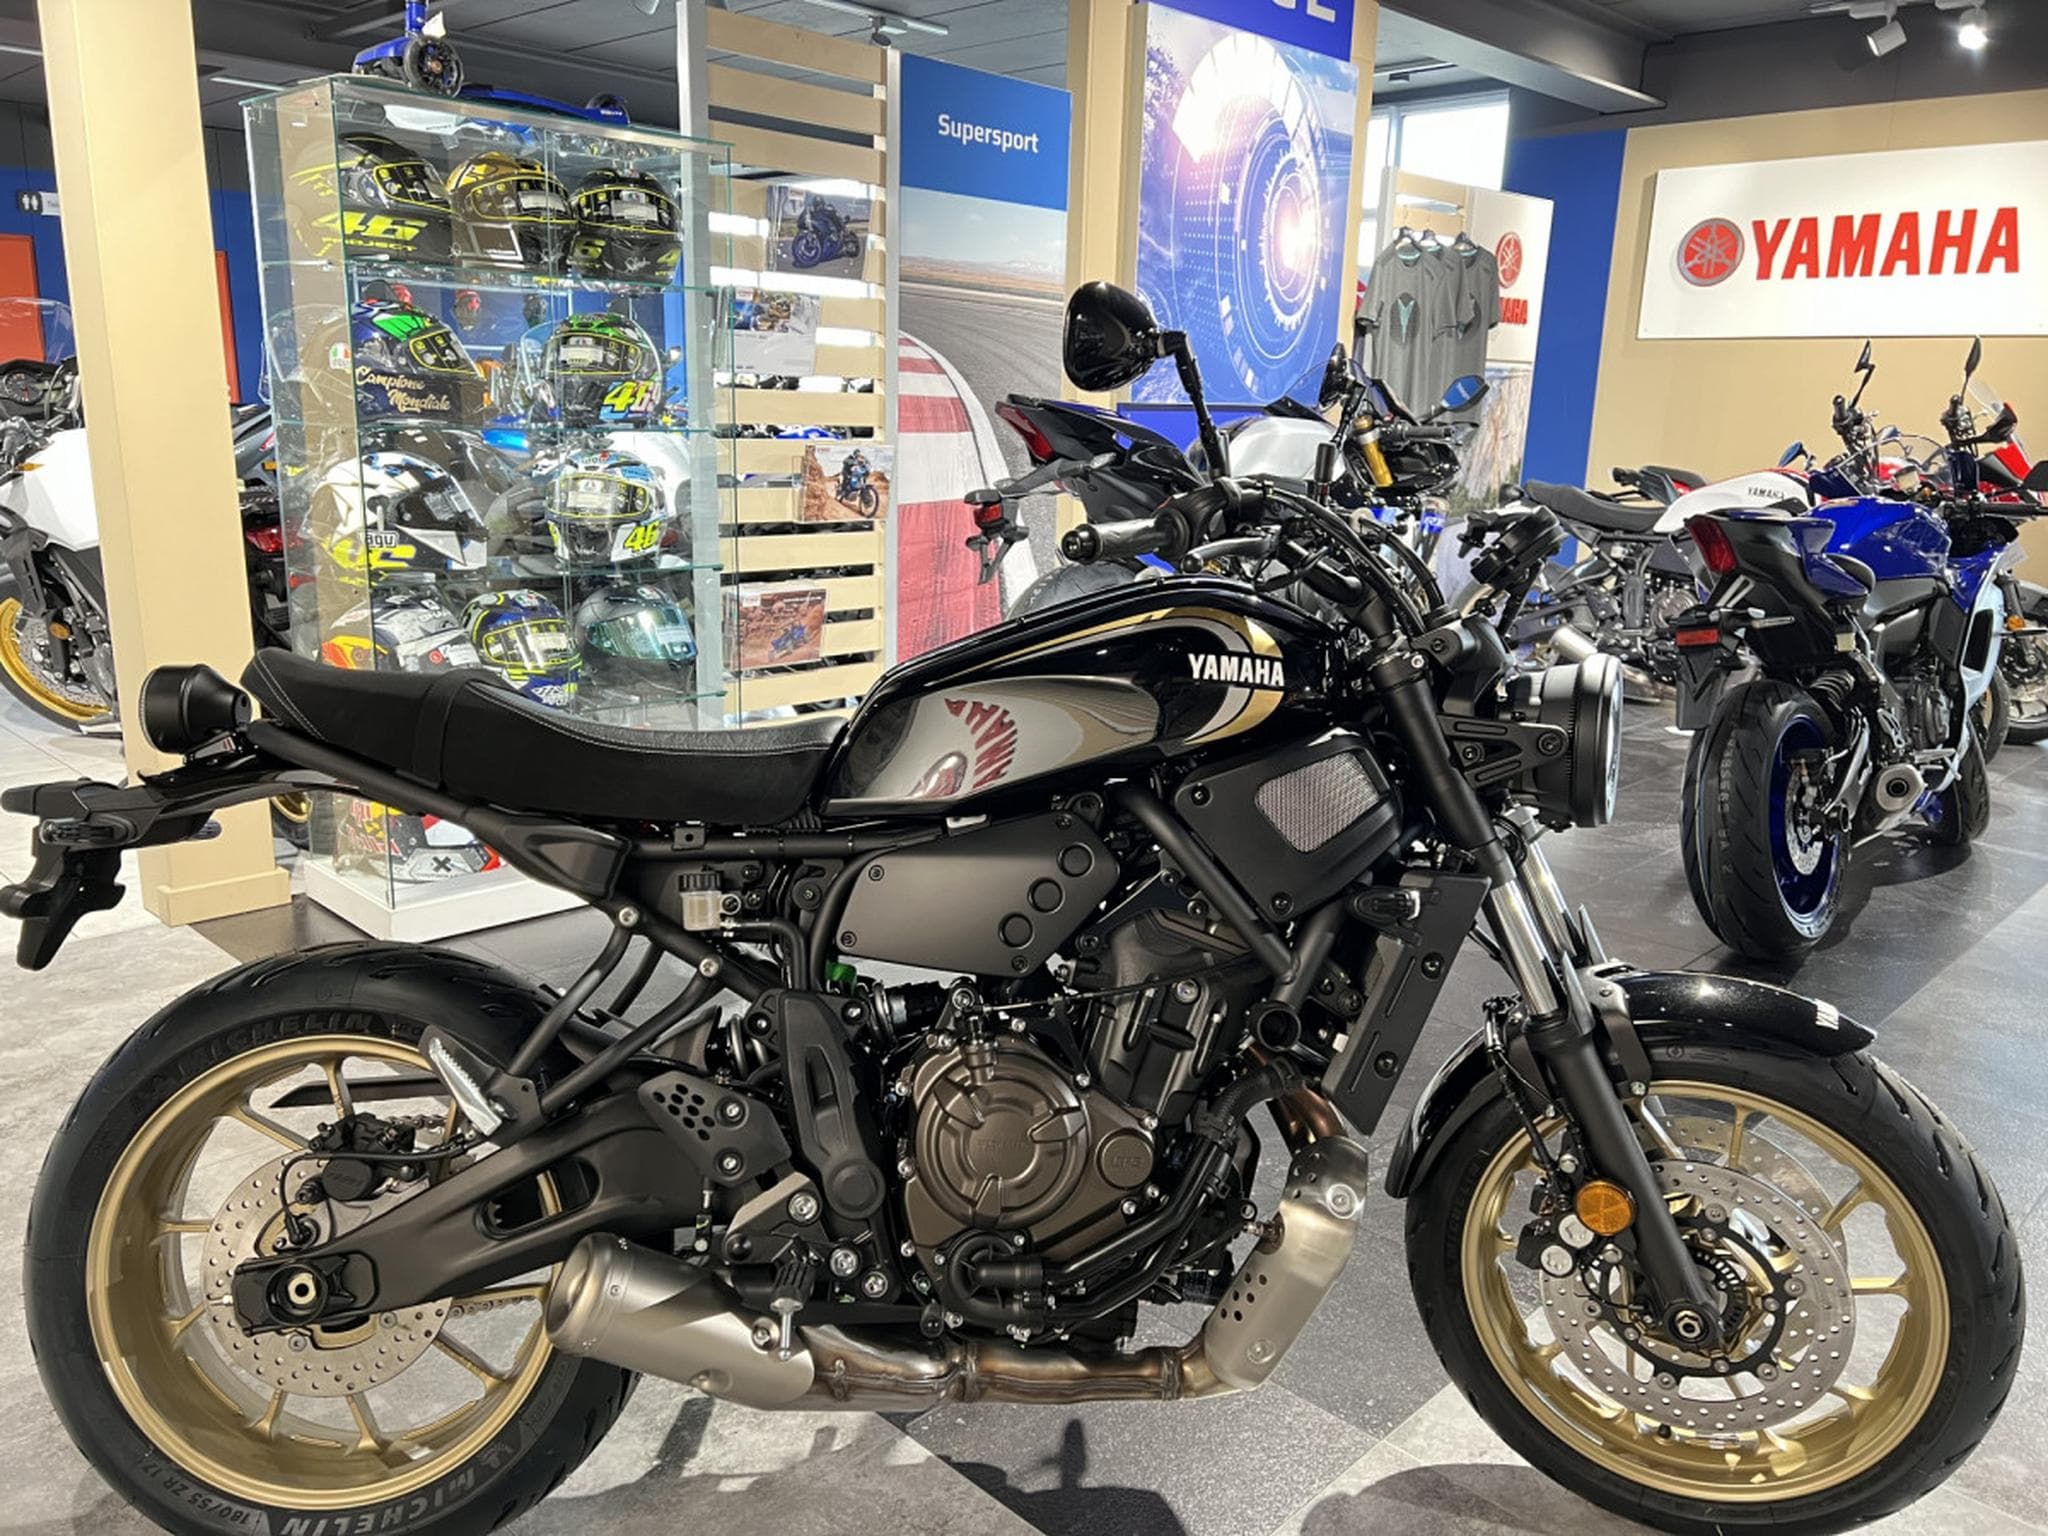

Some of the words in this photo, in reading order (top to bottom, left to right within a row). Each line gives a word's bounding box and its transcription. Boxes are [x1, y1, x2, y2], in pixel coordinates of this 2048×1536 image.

[937, 112, 1040, 154] Supersport
[1751, 206, 2020, 281] YAMAHA
[354, 364, 426, 394] Campione
[387, 389, 450, 412] Mondiale
[624, 520, 662, 552] 46
[1187, 653, 1285, 687] YAMAHA
[140, 1459, 162, 1479] 17
[162, 1475, 190, 1497] ZR
[280, 1466, 476, 1536] MICHELIN
[187, 1491, 252, 1526] 180/55
